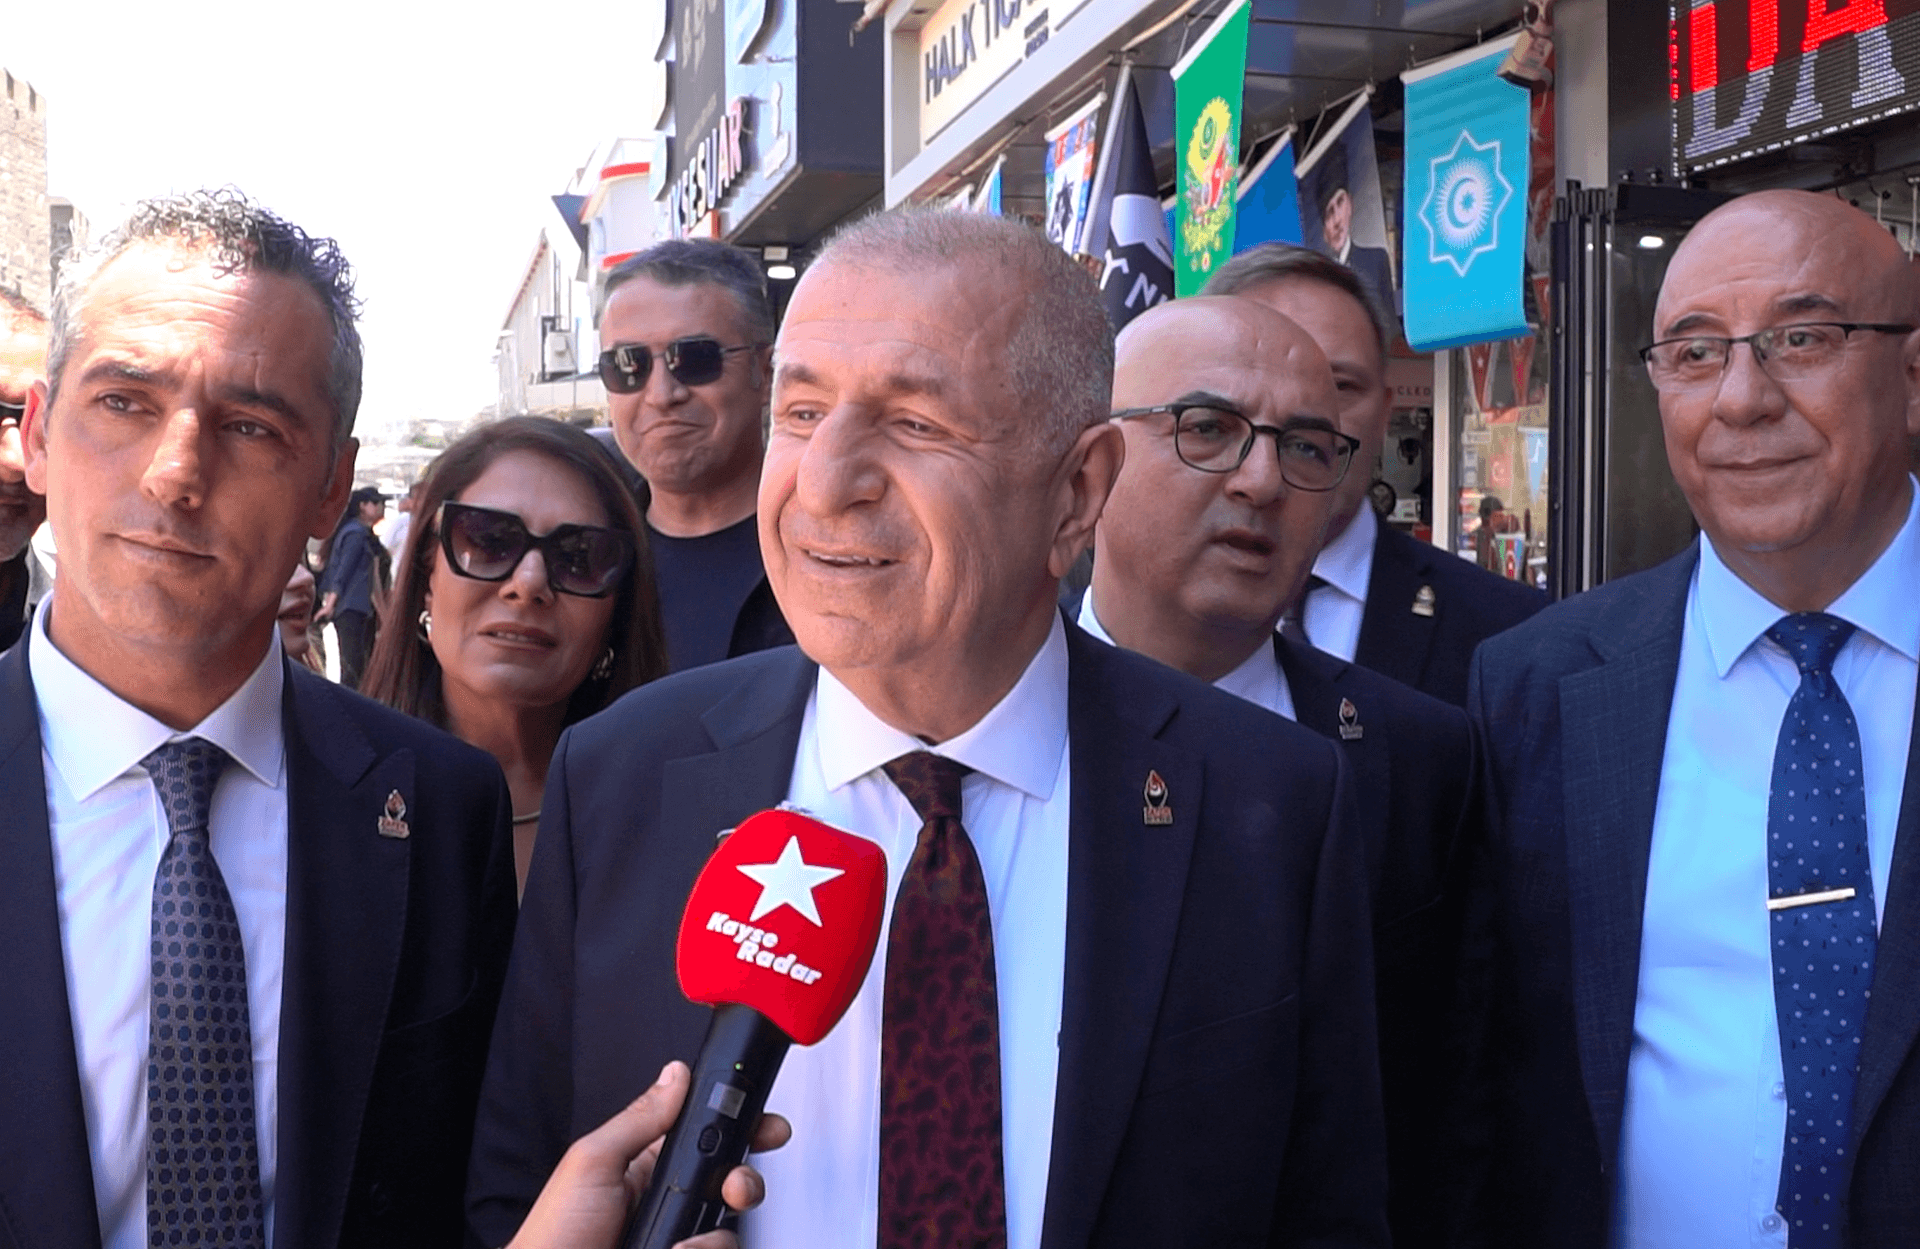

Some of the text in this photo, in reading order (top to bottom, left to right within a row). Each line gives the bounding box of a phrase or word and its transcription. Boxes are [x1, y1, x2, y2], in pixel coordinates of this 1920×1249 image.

[924, 2, 976, 105] HALK
[706, 911, 779, 948] Kayse
[736, 940, 823, 986] Radar
